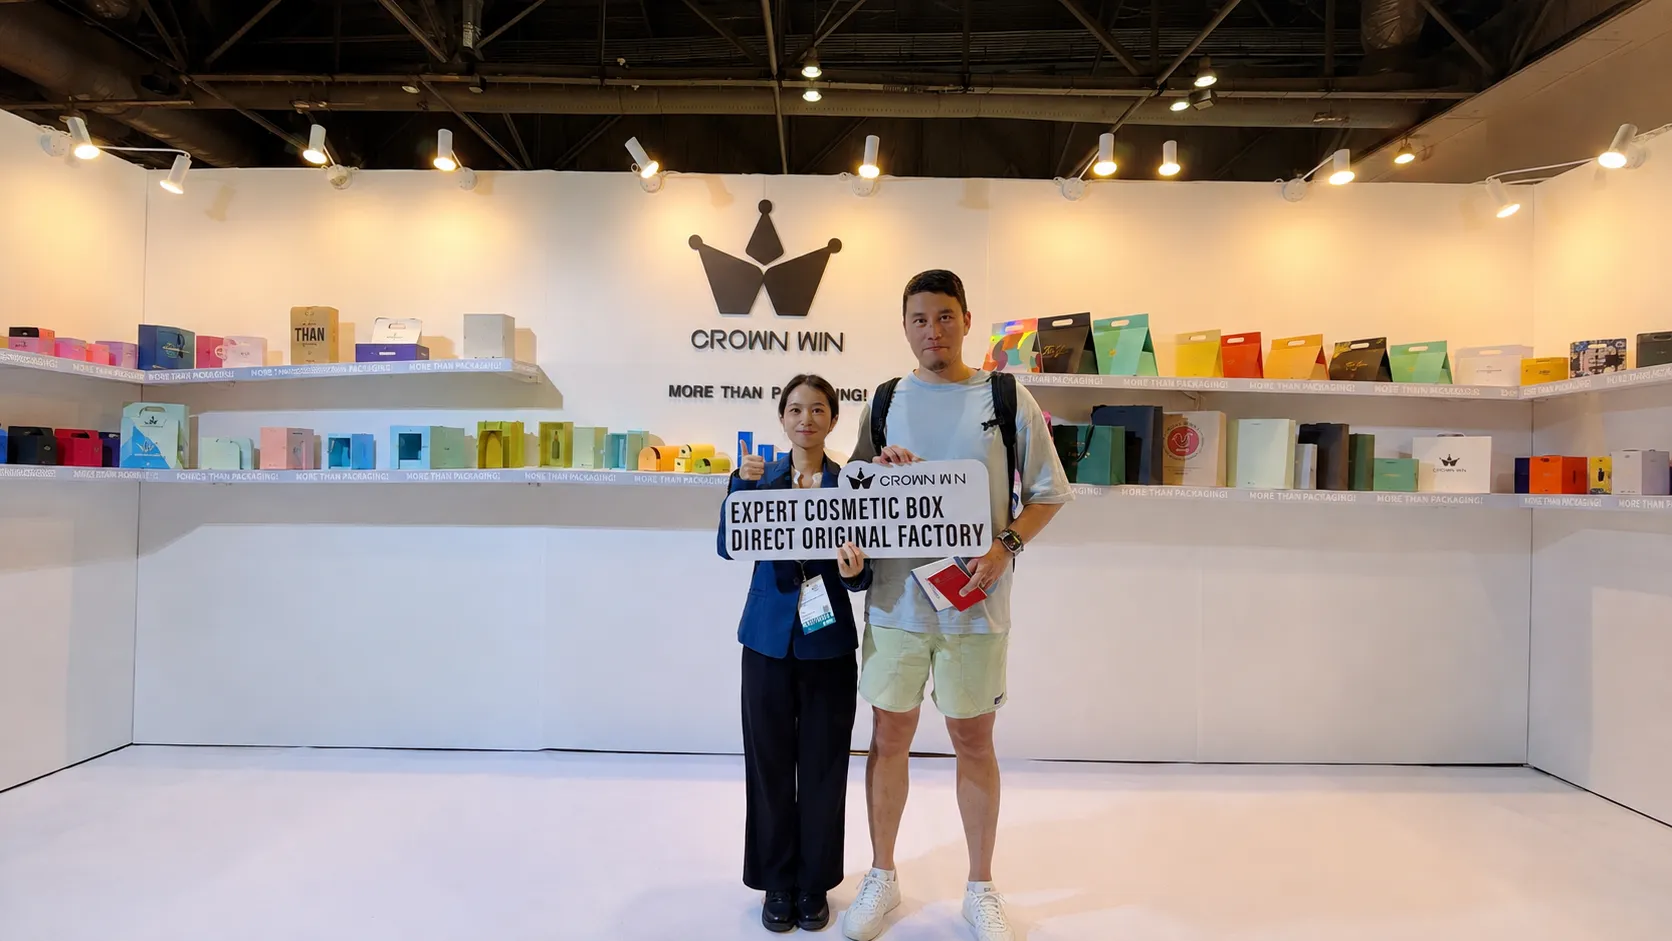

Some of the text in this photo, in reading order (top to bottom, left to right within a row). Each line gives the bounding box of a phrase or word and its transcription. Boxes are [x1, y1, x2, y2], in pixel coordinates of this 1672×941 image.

[295, 327, 325, 342] THAN
[691, 329, 844, 353] CROWN WIN
[668, 384, 868, 402] MORE THAN PING!
[879, 473, 966, 486] CROWN WN
[1121, 488, 1147, 496] MORE
[1149, 488, 1173, 497] THAN
[1249, 491, 1274, 500] MORE
[1276, 492, 1301, 501] THAN
[1376, 494, 1403, 503] MORE
[731, 496, 944, 524] EXPERT COSMETIC BOX
[732, 523, 985, 551] DIRECT ORIGINAL FACTORY
